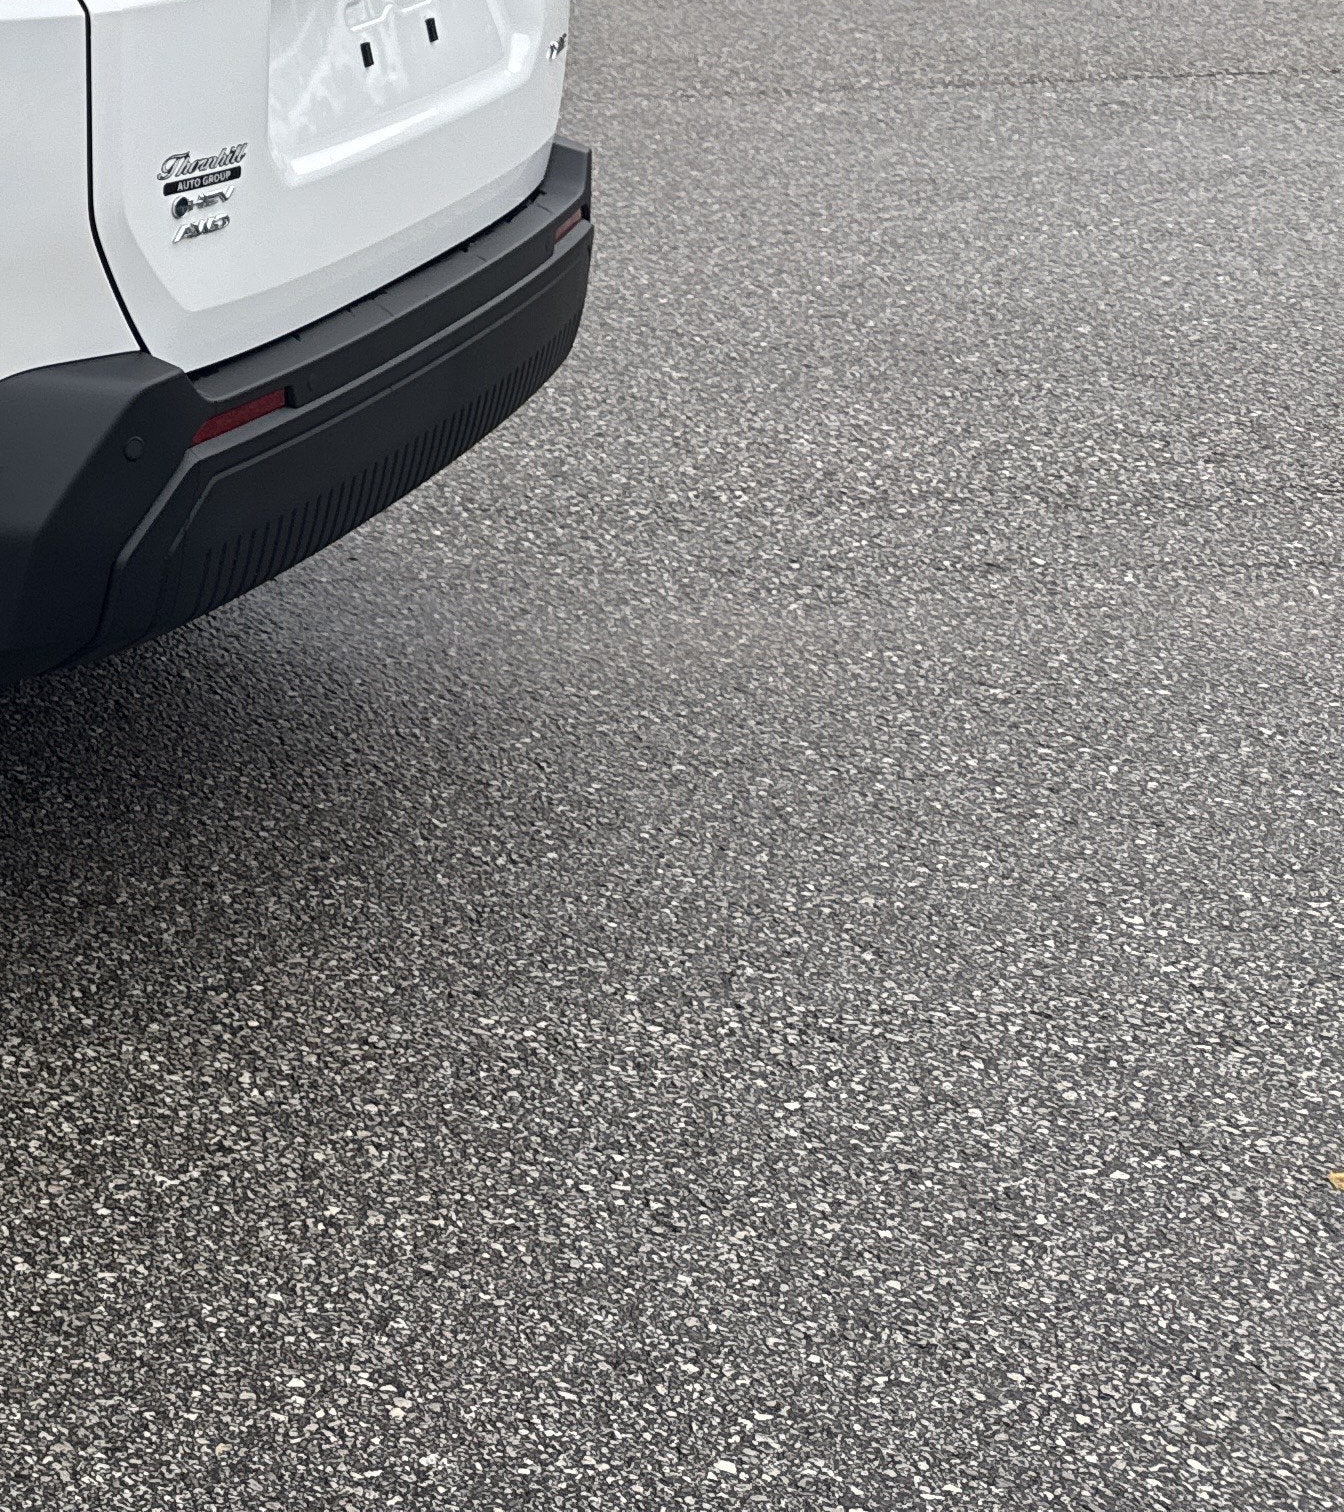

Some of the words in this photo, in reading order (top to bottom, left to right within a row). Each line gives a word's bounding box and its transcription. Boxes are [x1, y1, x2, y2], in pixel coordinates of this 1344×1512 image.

[157, 142, 248, 180] Thornhill
[176, 178, 202, 192] AUTO
[202, 170, 233, 186] GROUP
[172, 213, 231, 244] AWD
